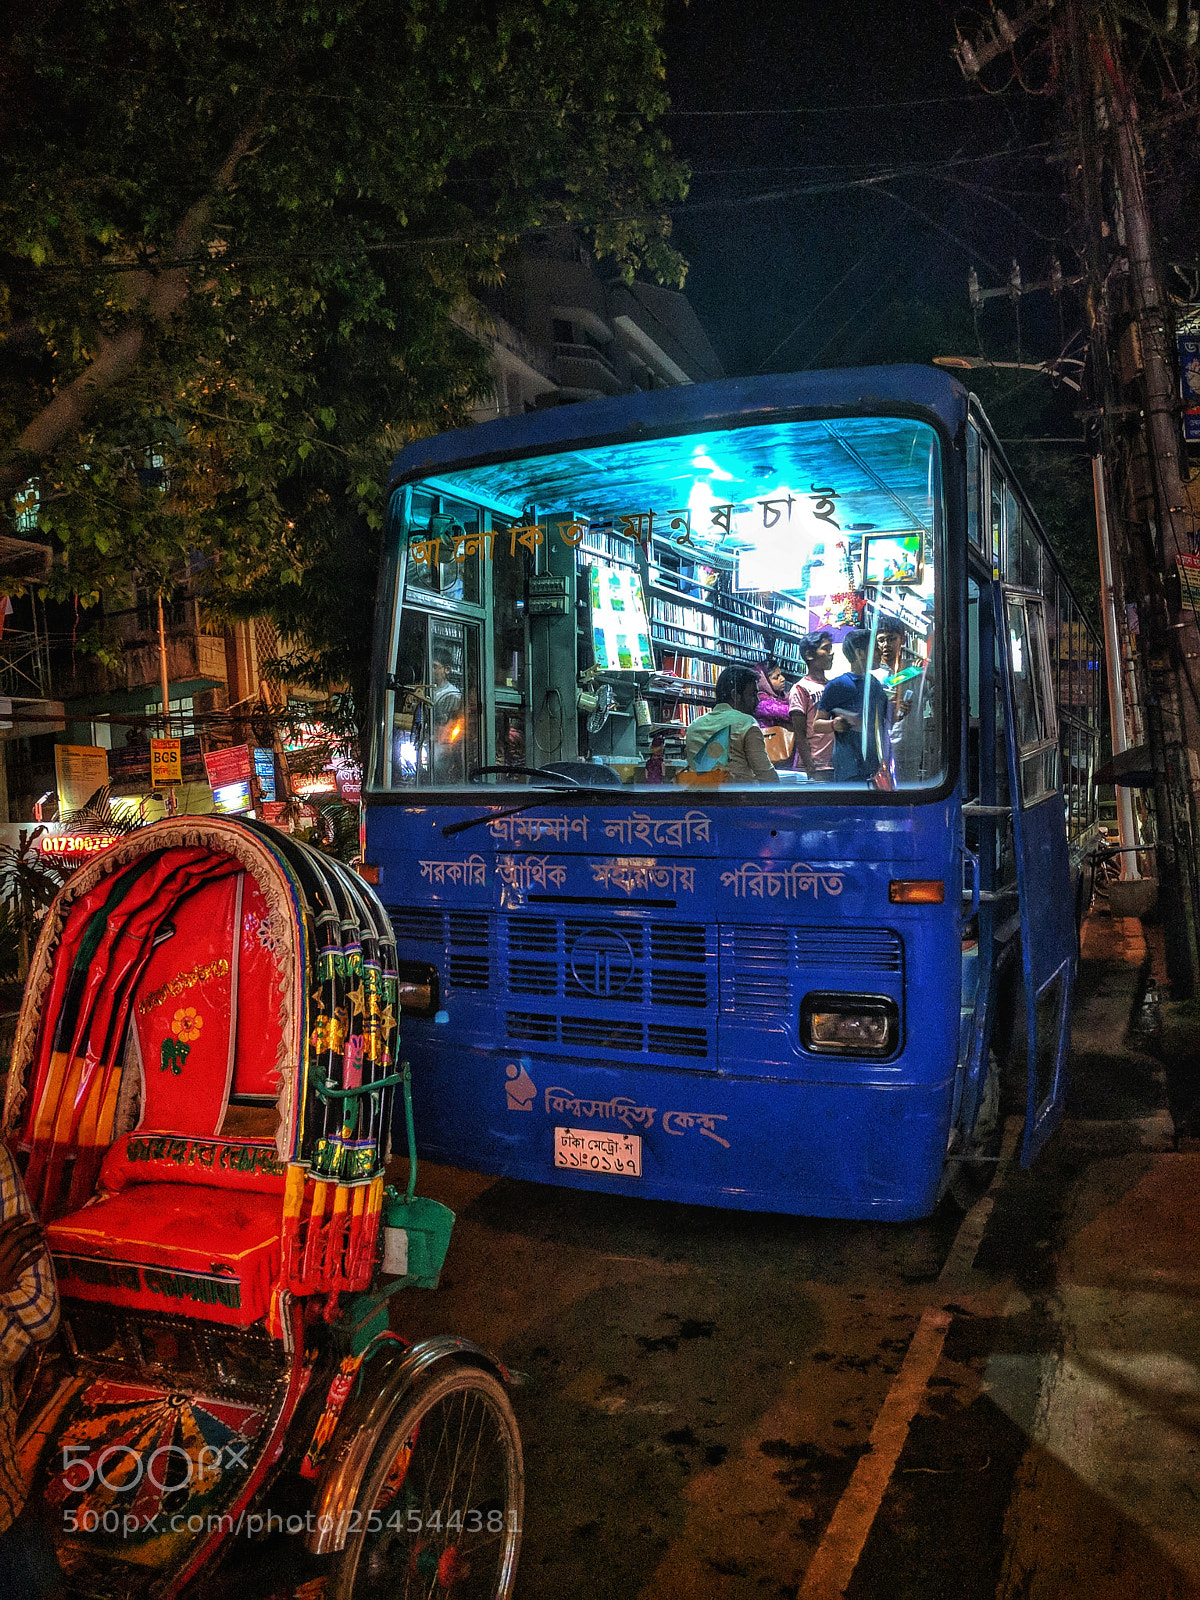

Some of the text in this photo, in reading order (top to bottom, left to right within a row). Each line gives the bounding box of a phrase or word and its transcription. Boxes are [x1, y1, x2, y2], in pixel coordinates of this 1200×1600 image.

[410, 483, 841, 568] আলোকিত মানুষ চাই
[154, 752, 177, 763] BCS
[489, 810, 713, 848] ভ্রাম্যমাণ লাইব্রেরি
[418, 854, 845, 899] সরকারি আর্থিক সহায়তায় পরিচালিত
[545, 1086, 730, 1148] বিশ্বসাহিত্য কেন্দ্র
